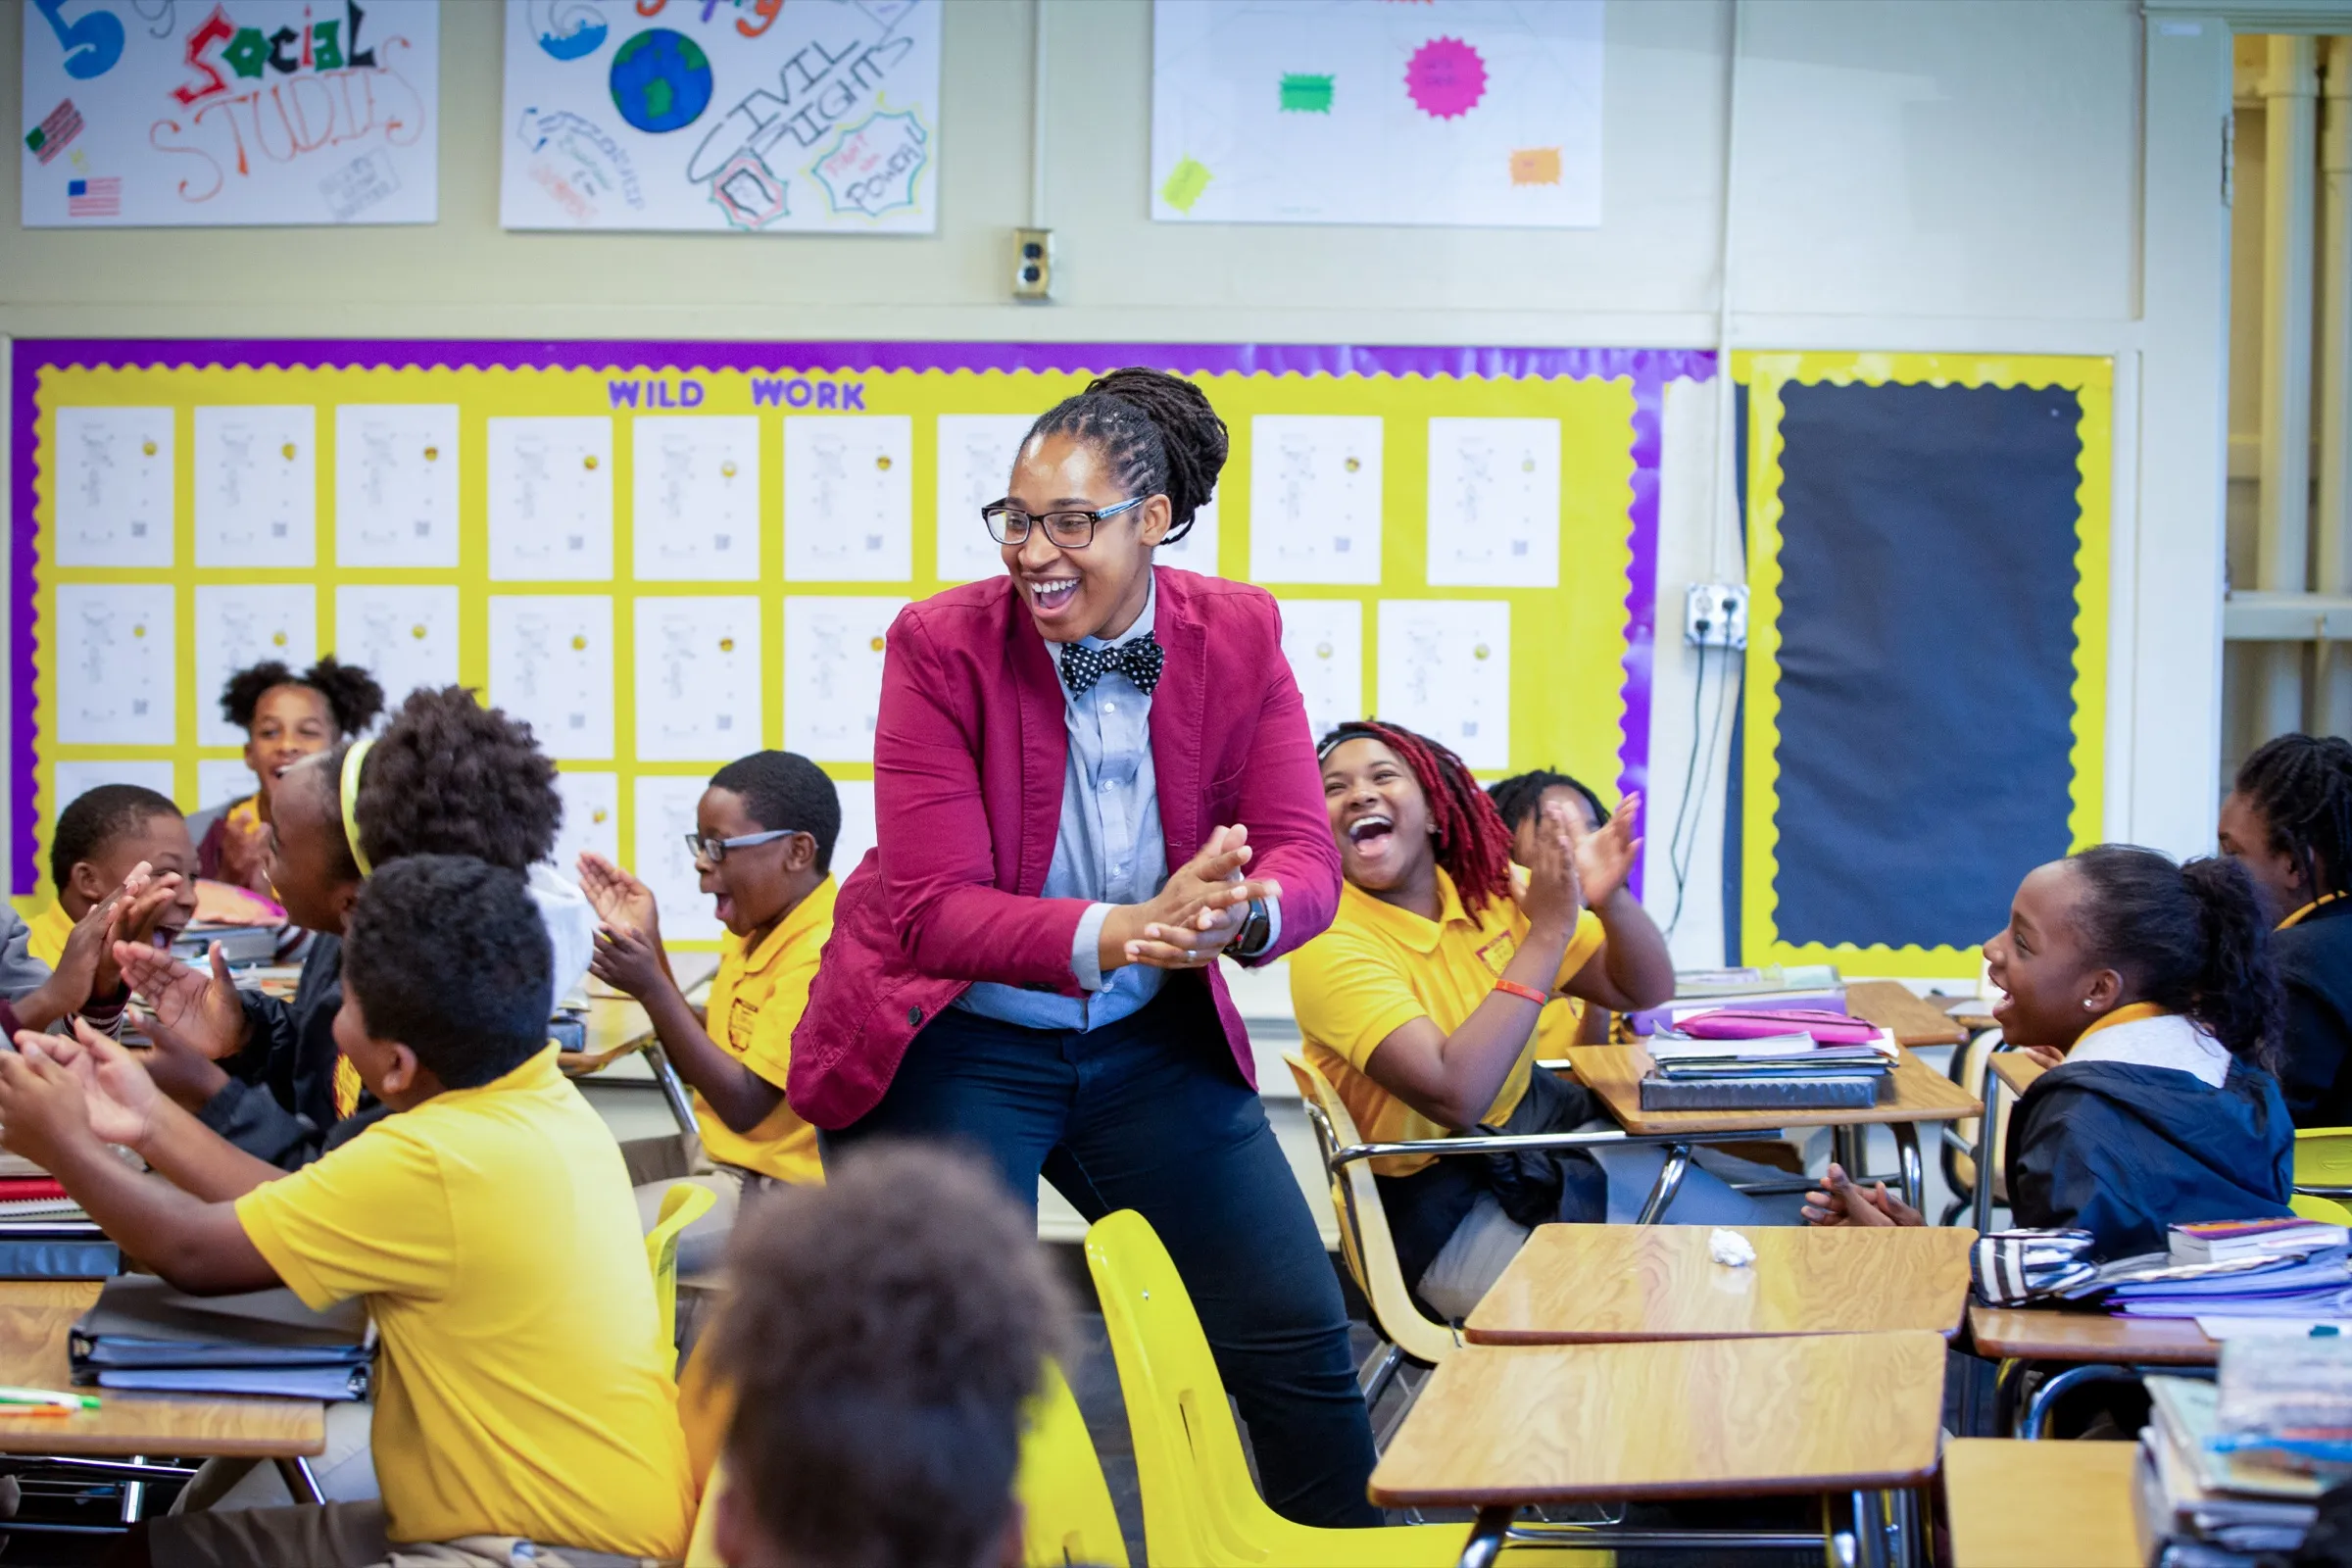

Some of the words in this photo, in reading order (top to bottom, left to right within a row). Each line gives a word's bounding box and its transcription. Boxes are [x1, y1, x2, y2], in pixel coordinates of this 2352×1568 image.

[687, 39, 860, 184] CIVIL
[608, 379, 705, 410] WILD
[751, 376, 866, 412] WORK
